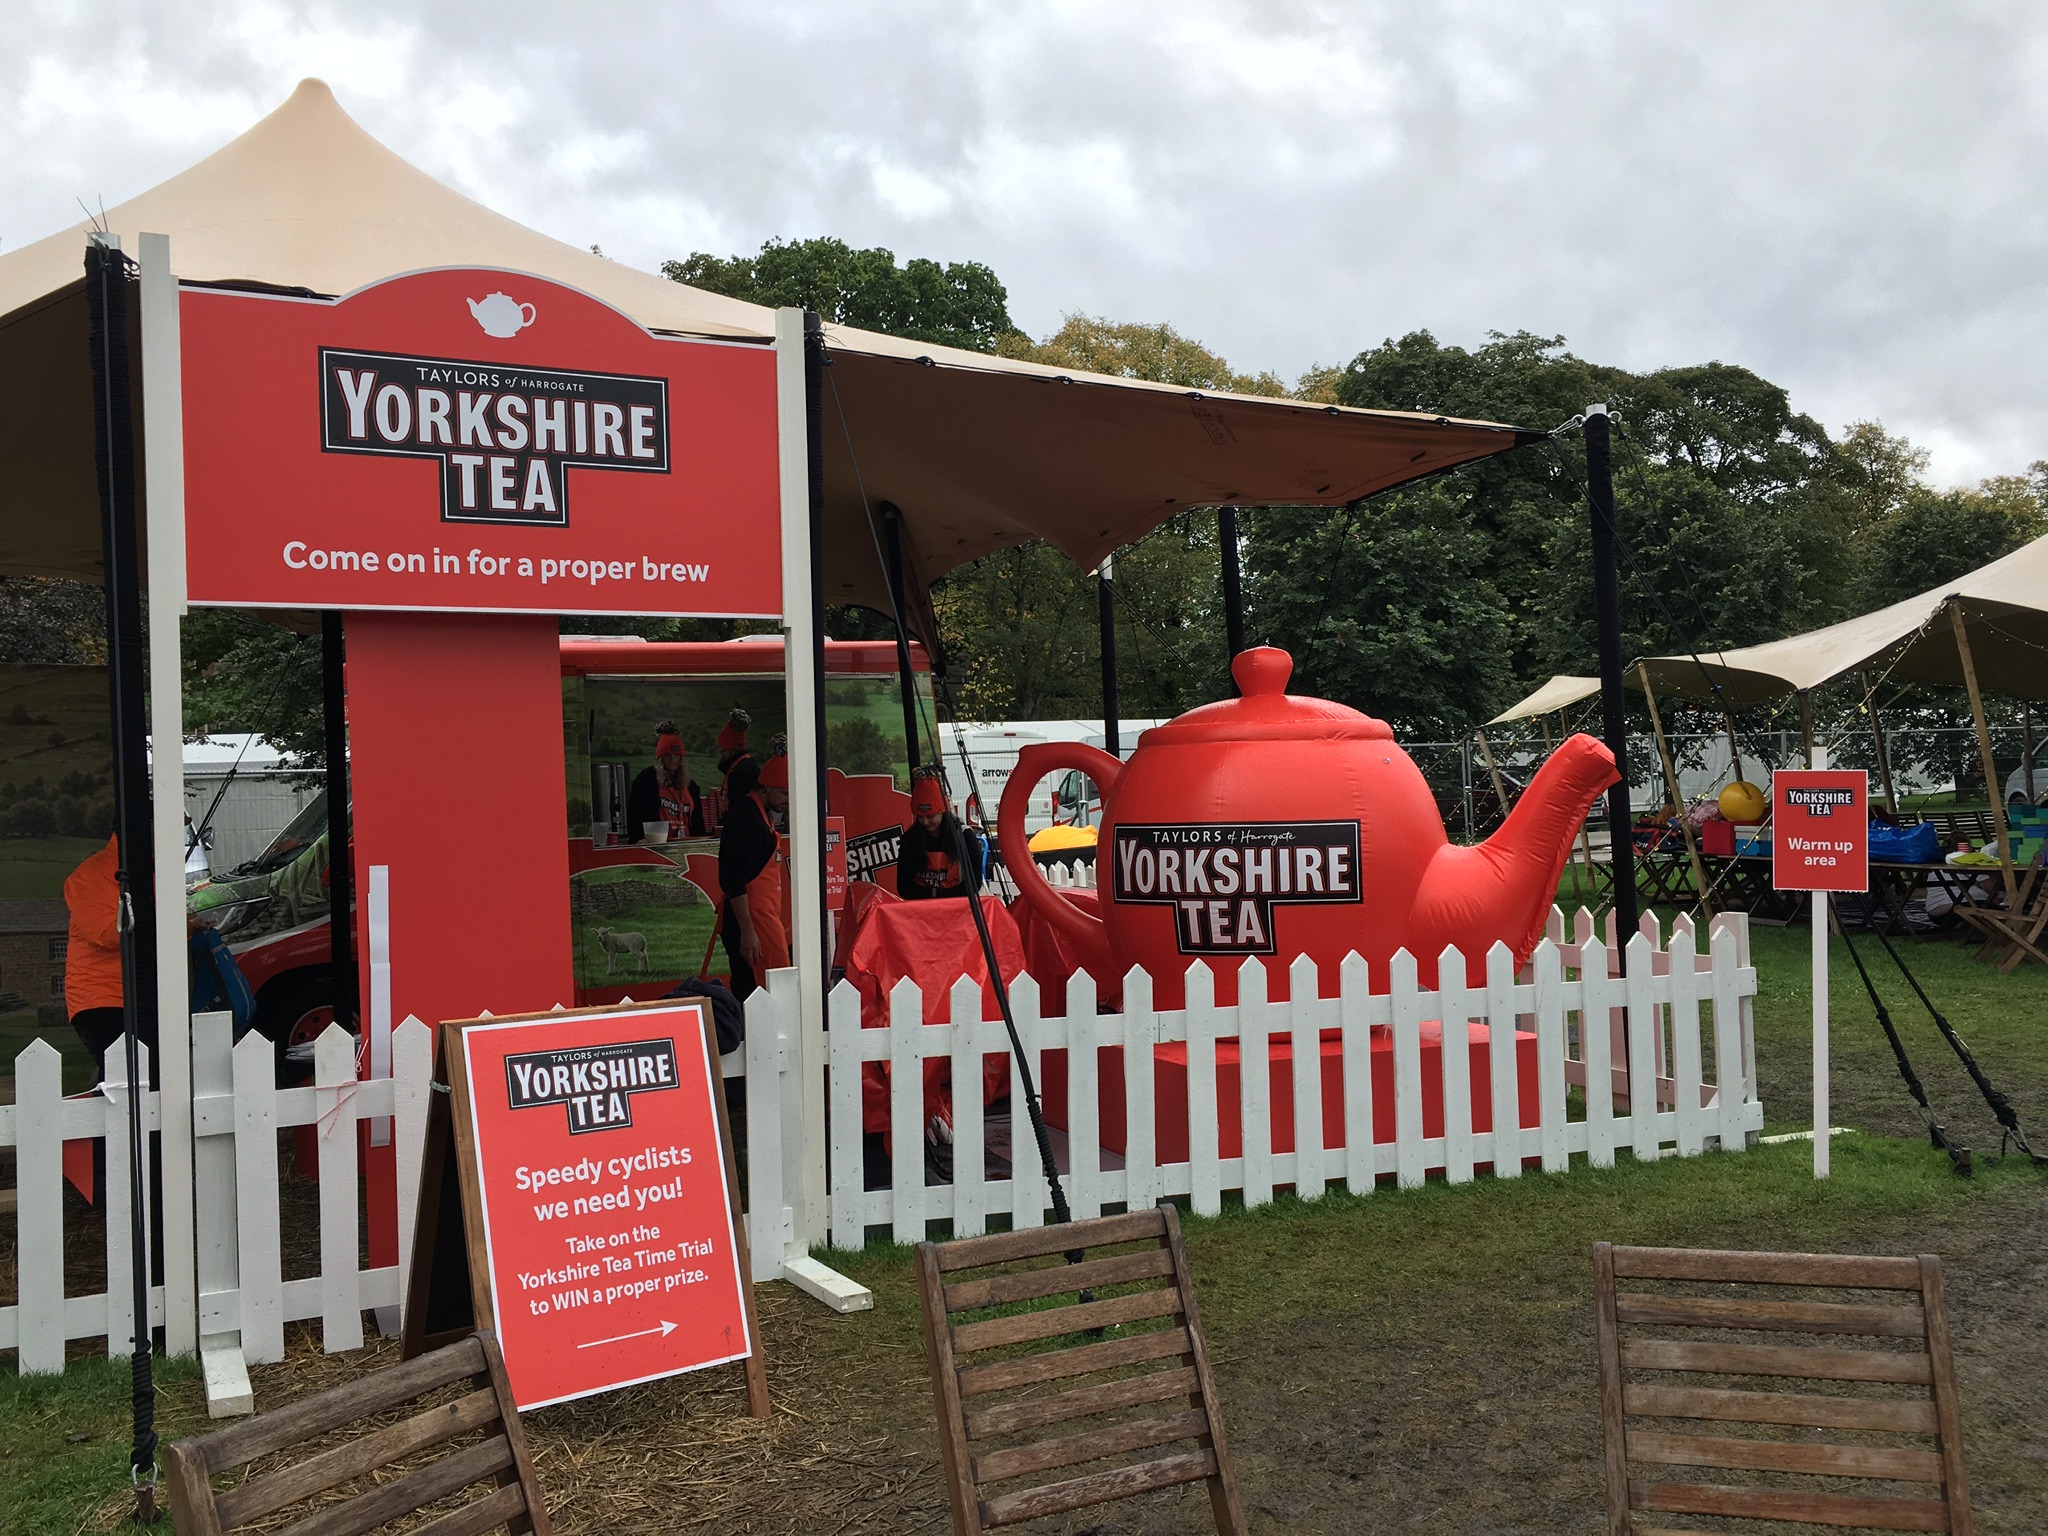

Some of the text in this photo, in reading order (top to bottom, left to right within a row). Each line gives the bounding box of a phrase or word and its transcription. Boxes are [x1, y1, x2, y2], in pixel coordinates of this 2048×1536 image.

[417, 367, 585, 392] TAYLORS of HARROGATE
[337, 369, 656, 458] YORKSHIRE
[451, 453, 557, 512] TEA
[283, 540, 710, 585] Come on in for a proper brew
[1788, 790, 1852, 804] YORKSHIRE
[1809, 803, 1831, 815] TEA
[1153, 829, 1297, 846] TAYLORS of Harrogate
[1787, 837, 1853, 854] Warm up
[1118, 839, 1351, 894] YORKSHIRE
[1804, 856, 1836, 866] area
[1179, 899, 1266, 944] TEA
[513, 1053, 672, 1099] YORKSHIRE
[550, 1051, 592, 1063] TAYLORS
[601, 1048, 633, 1057] HARROGATE
[571, 1092, 626, 1126] TEA
[515, 1145, 693, 1194] Speedy cyclists
[533, 1176, 684, 1222] we need you!
[565, 1224, 661, 1254] Take on the
[517, 1238, 713, 1290] Yorkshire Tea Time Trial
[529, 1268, 710, 1316] to WIN a proper prize.
